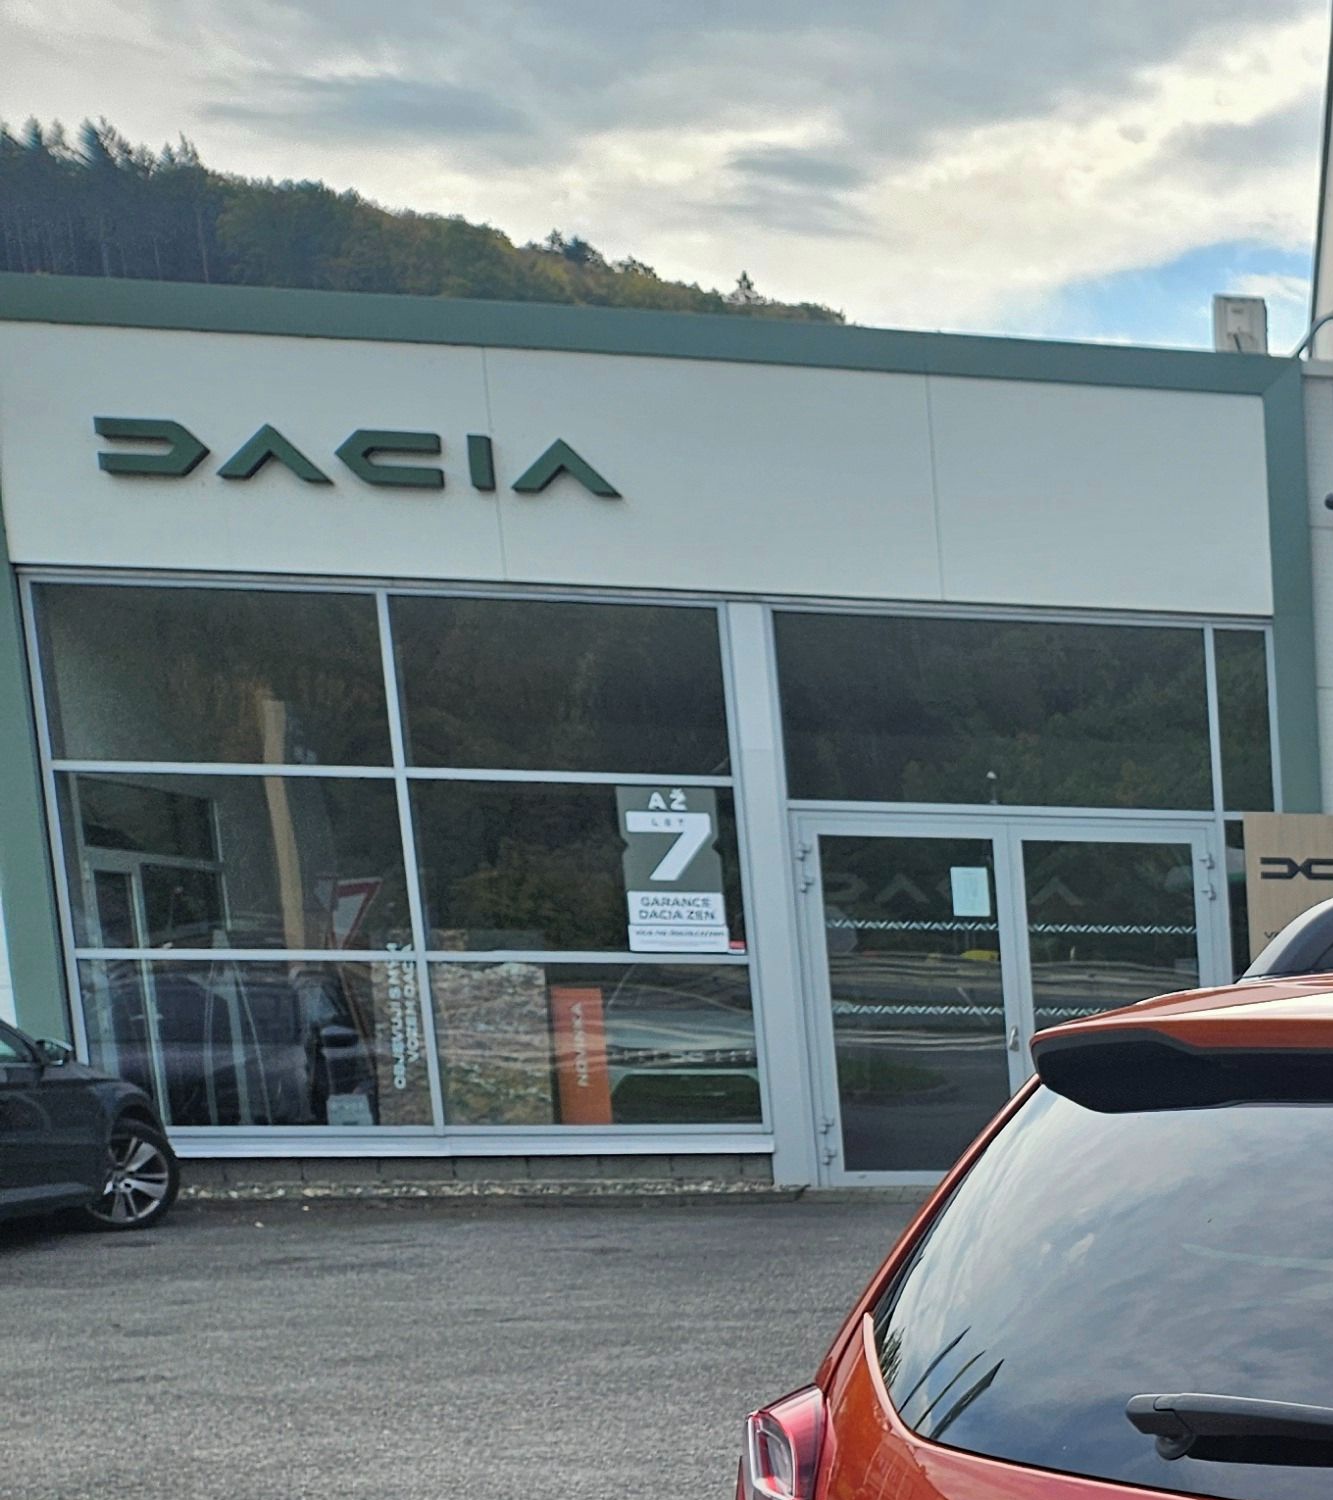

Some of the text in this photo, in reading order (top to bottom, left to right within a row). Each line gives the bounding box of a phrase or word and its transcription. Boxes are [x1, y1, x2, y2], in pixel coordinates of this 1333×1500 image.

[93, 416, 622, 499] DACIA
[648, 787, 688, 811] AŽ
[625, 811, 712, 881] 7
[638, 909, 716, 921] DACIA ZEN
[640, 896, 712, 907] GARANCE
[401, 943, 416, 995] DACA
